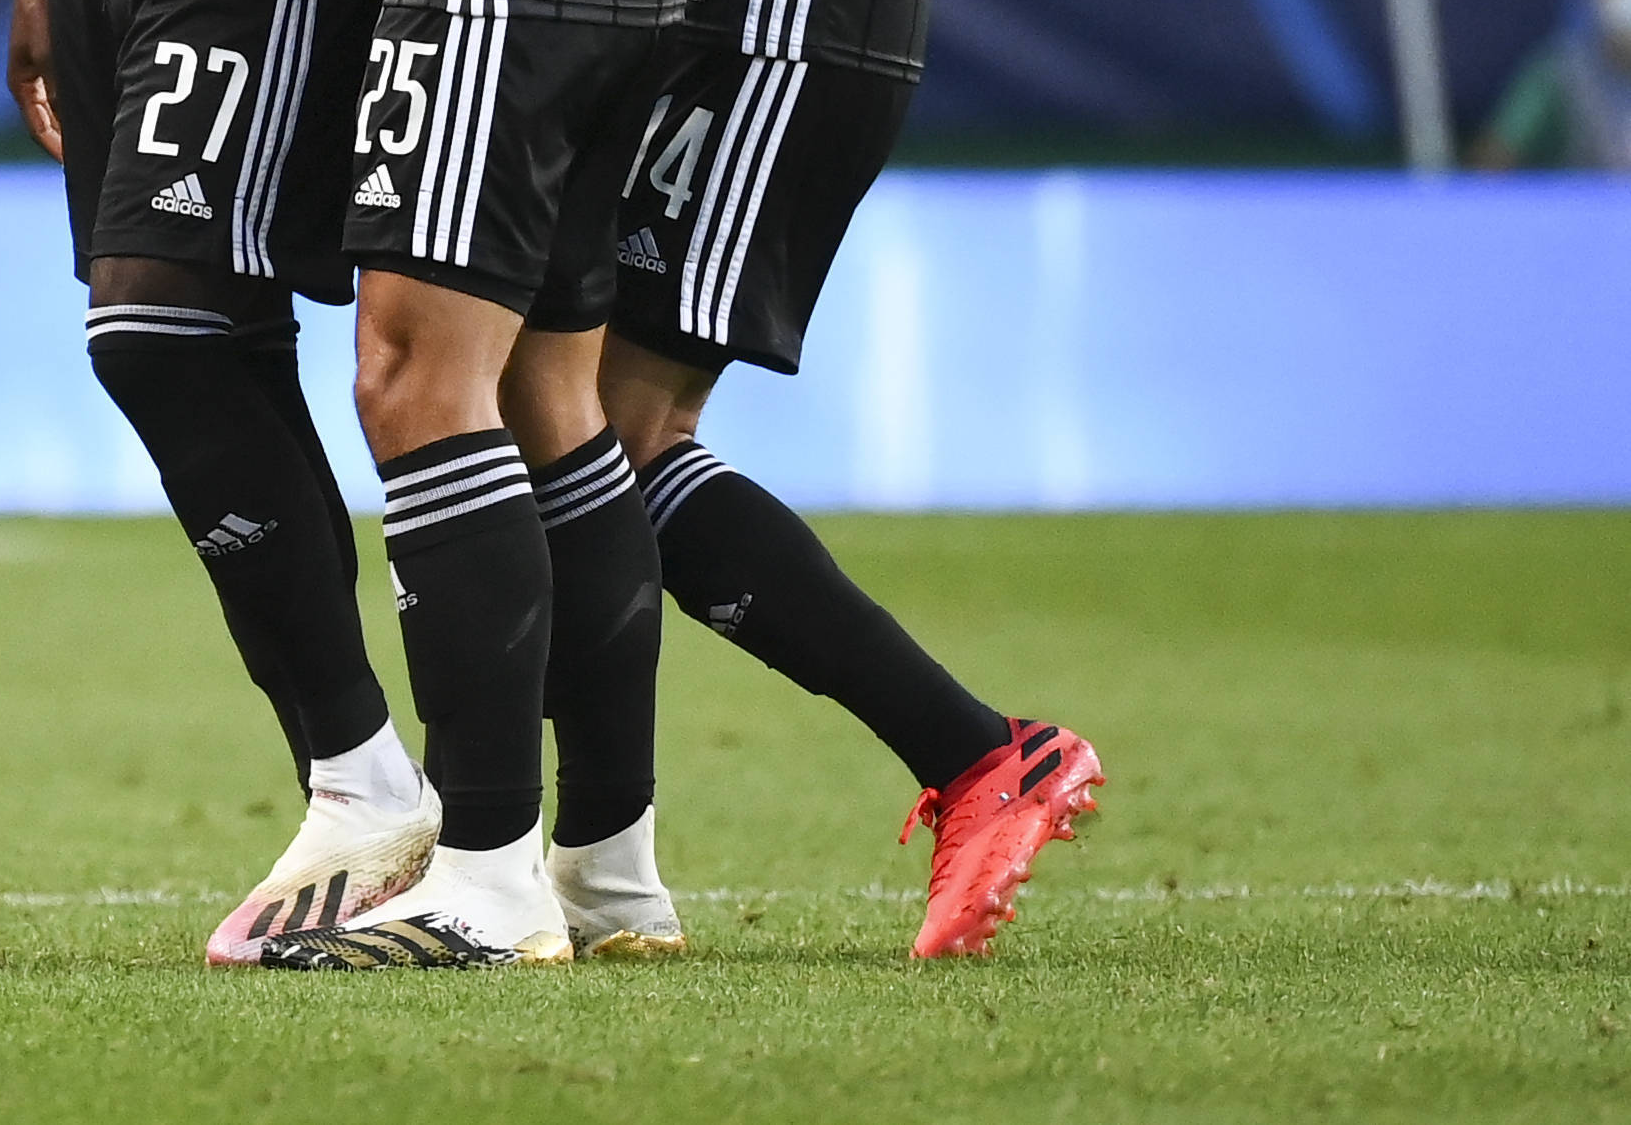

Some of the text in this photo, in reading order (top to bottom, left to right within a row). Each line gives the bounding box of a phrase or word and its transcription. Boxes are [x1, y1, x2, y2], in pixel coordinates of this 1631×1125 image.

[137, 41, 250, 163] 27
[354, 38, 439, 156] 25
[151, 193, 213, 220] adidas
[354, 190, 402, 209] adidas
